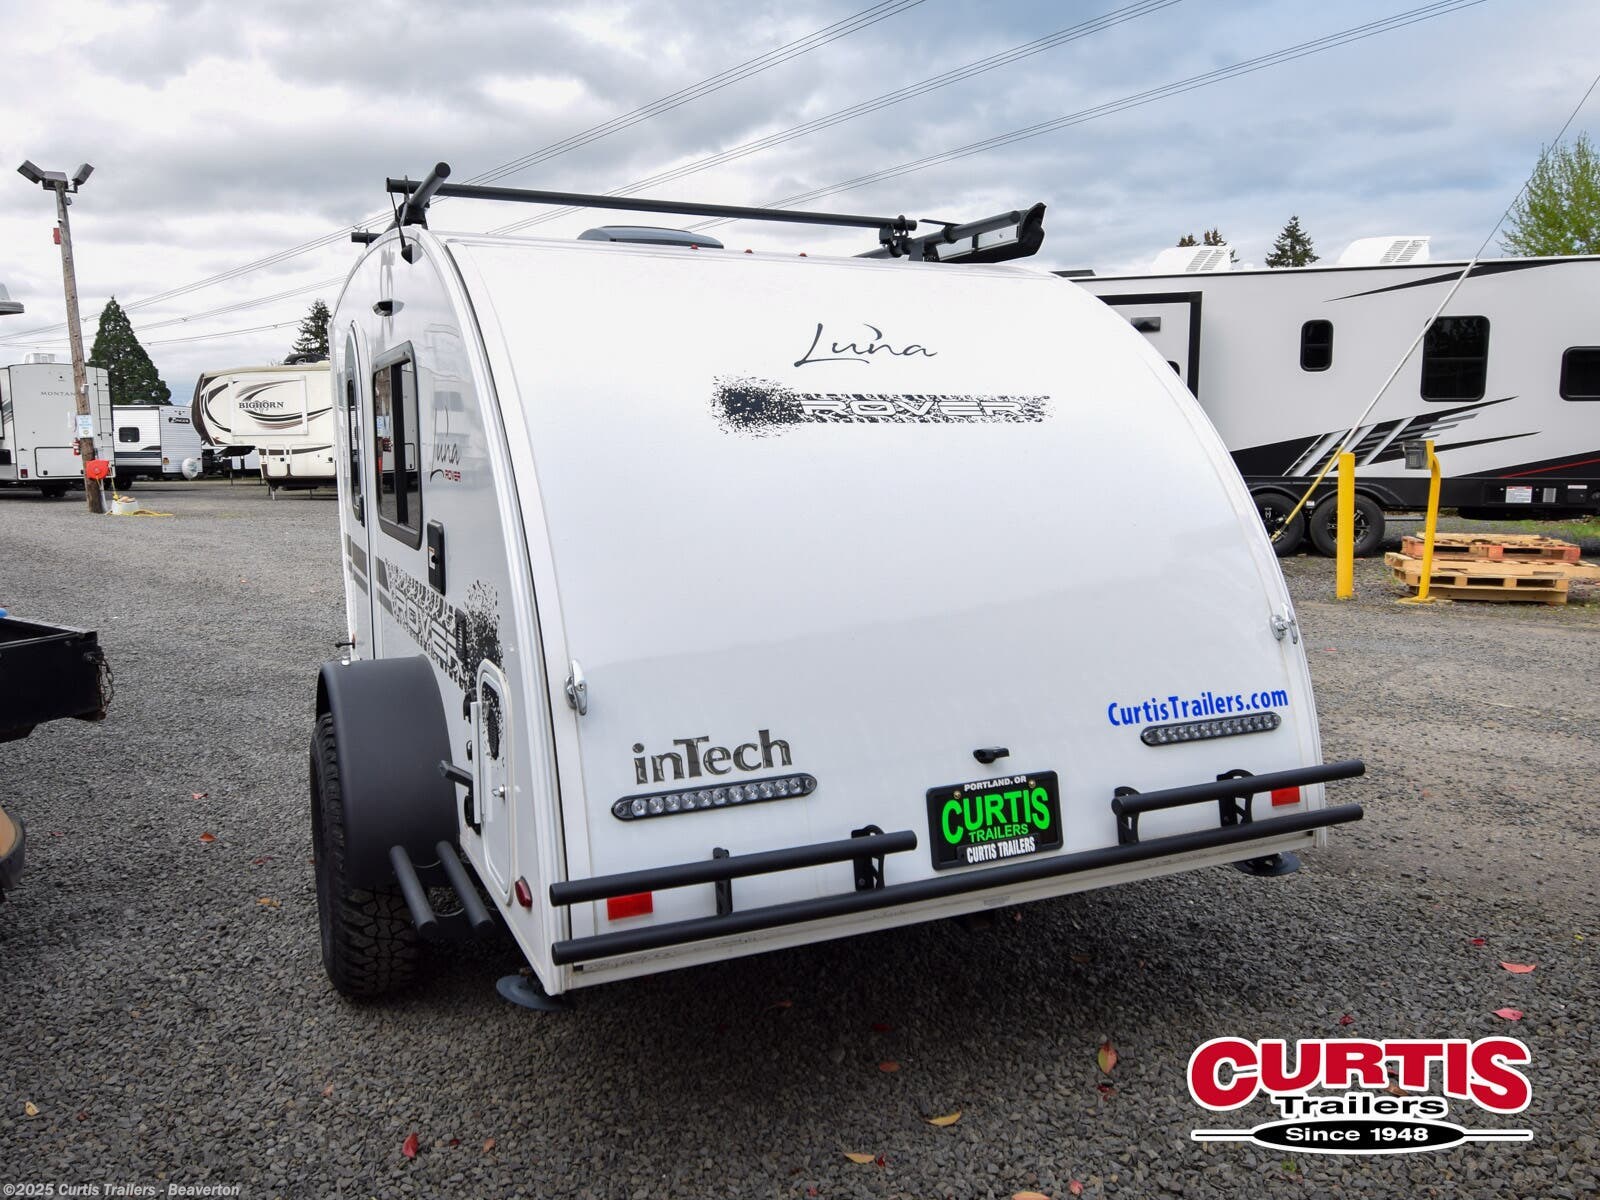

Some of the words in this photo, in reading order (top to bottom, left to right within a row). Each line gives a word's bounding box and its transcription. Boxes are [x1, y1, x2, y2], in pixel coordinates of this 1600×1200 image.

[794, 323, 938, 368] Luna
[239, 401, 284, 409] BIGHORN
[799, 399, 1024, 417] ROVER
[1107, 689, 1289, 726] CurtisTrailers.com
[632, 729, 793, 785] inTech
[1013, 775, 1027, 784] OR
[942, 787, 1050, 844] CURTIS
[968, 823, 1029, 843] TRAILERS
[966, 843, 997, 864] CURTIS
[997, 836, 1036, 858] TRAILERS
